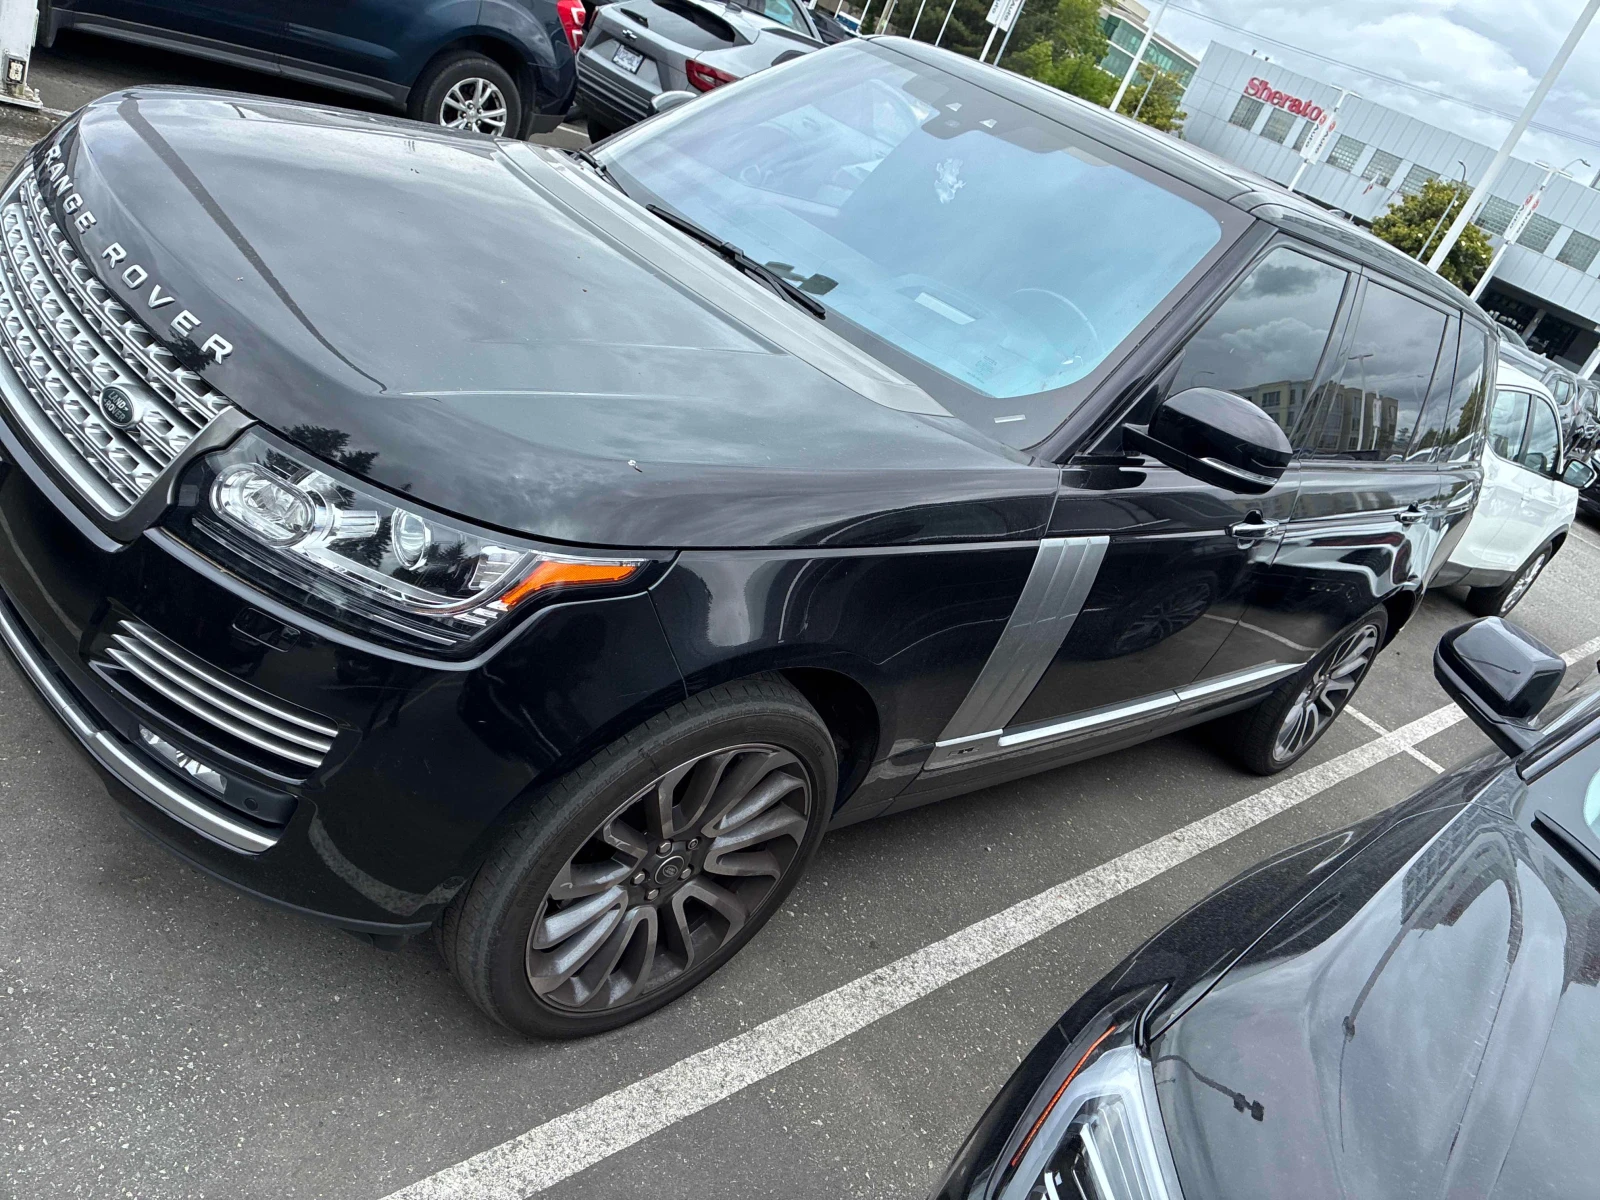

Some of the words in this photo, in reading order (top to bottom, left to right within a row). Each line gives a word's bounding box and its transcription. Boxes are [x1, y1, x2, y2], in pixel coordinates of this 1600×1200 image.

[1243, 77, 1323, 121] Sherato
[44, 145, 97, 234] RANGE
[102, 242, 234, 364] ROVER
[104, 400, 126, 422] ROVER
[108, 391, 126, 409] LAND
